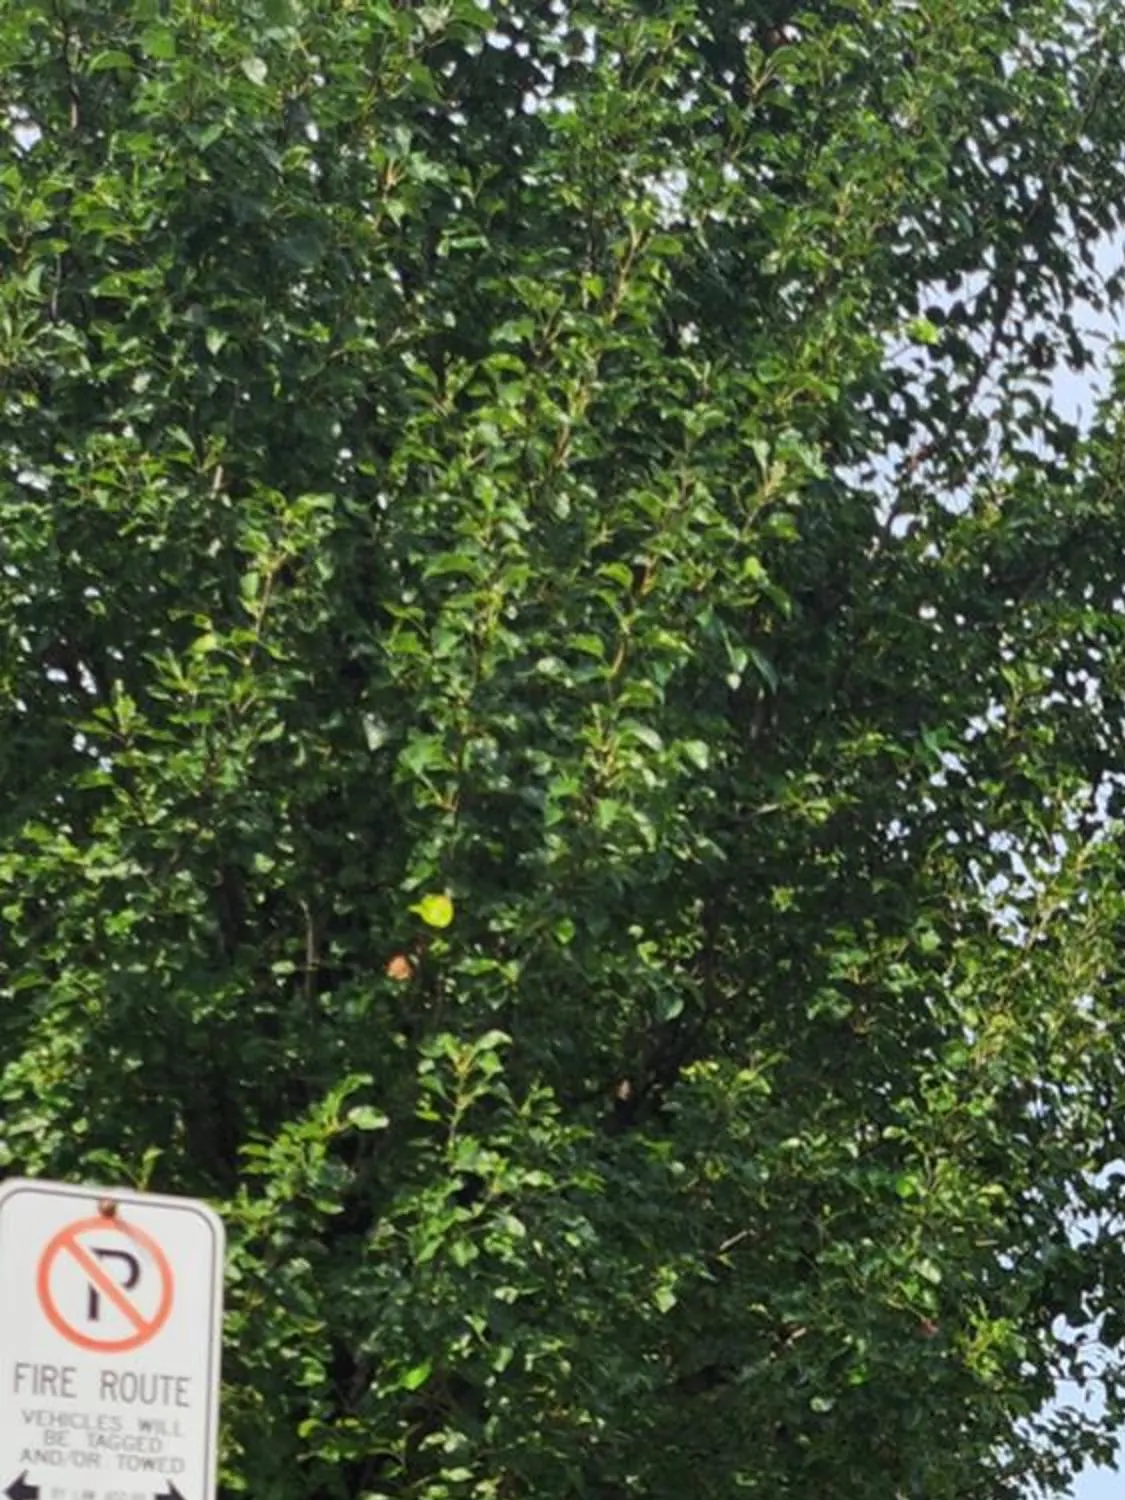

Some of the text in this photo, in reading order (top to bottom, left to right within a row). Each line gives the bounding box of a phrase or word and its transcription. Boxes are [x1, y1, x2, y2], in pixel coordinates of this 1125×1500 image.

[12, 1361, 192, 1408] FIRE ROUTE
[20, 1408, 185, 1438] VEHICLES WILL
[43, 1429, 163, 1454] BE TAGGED
[116, 1453, 186, 1475] TOWED
